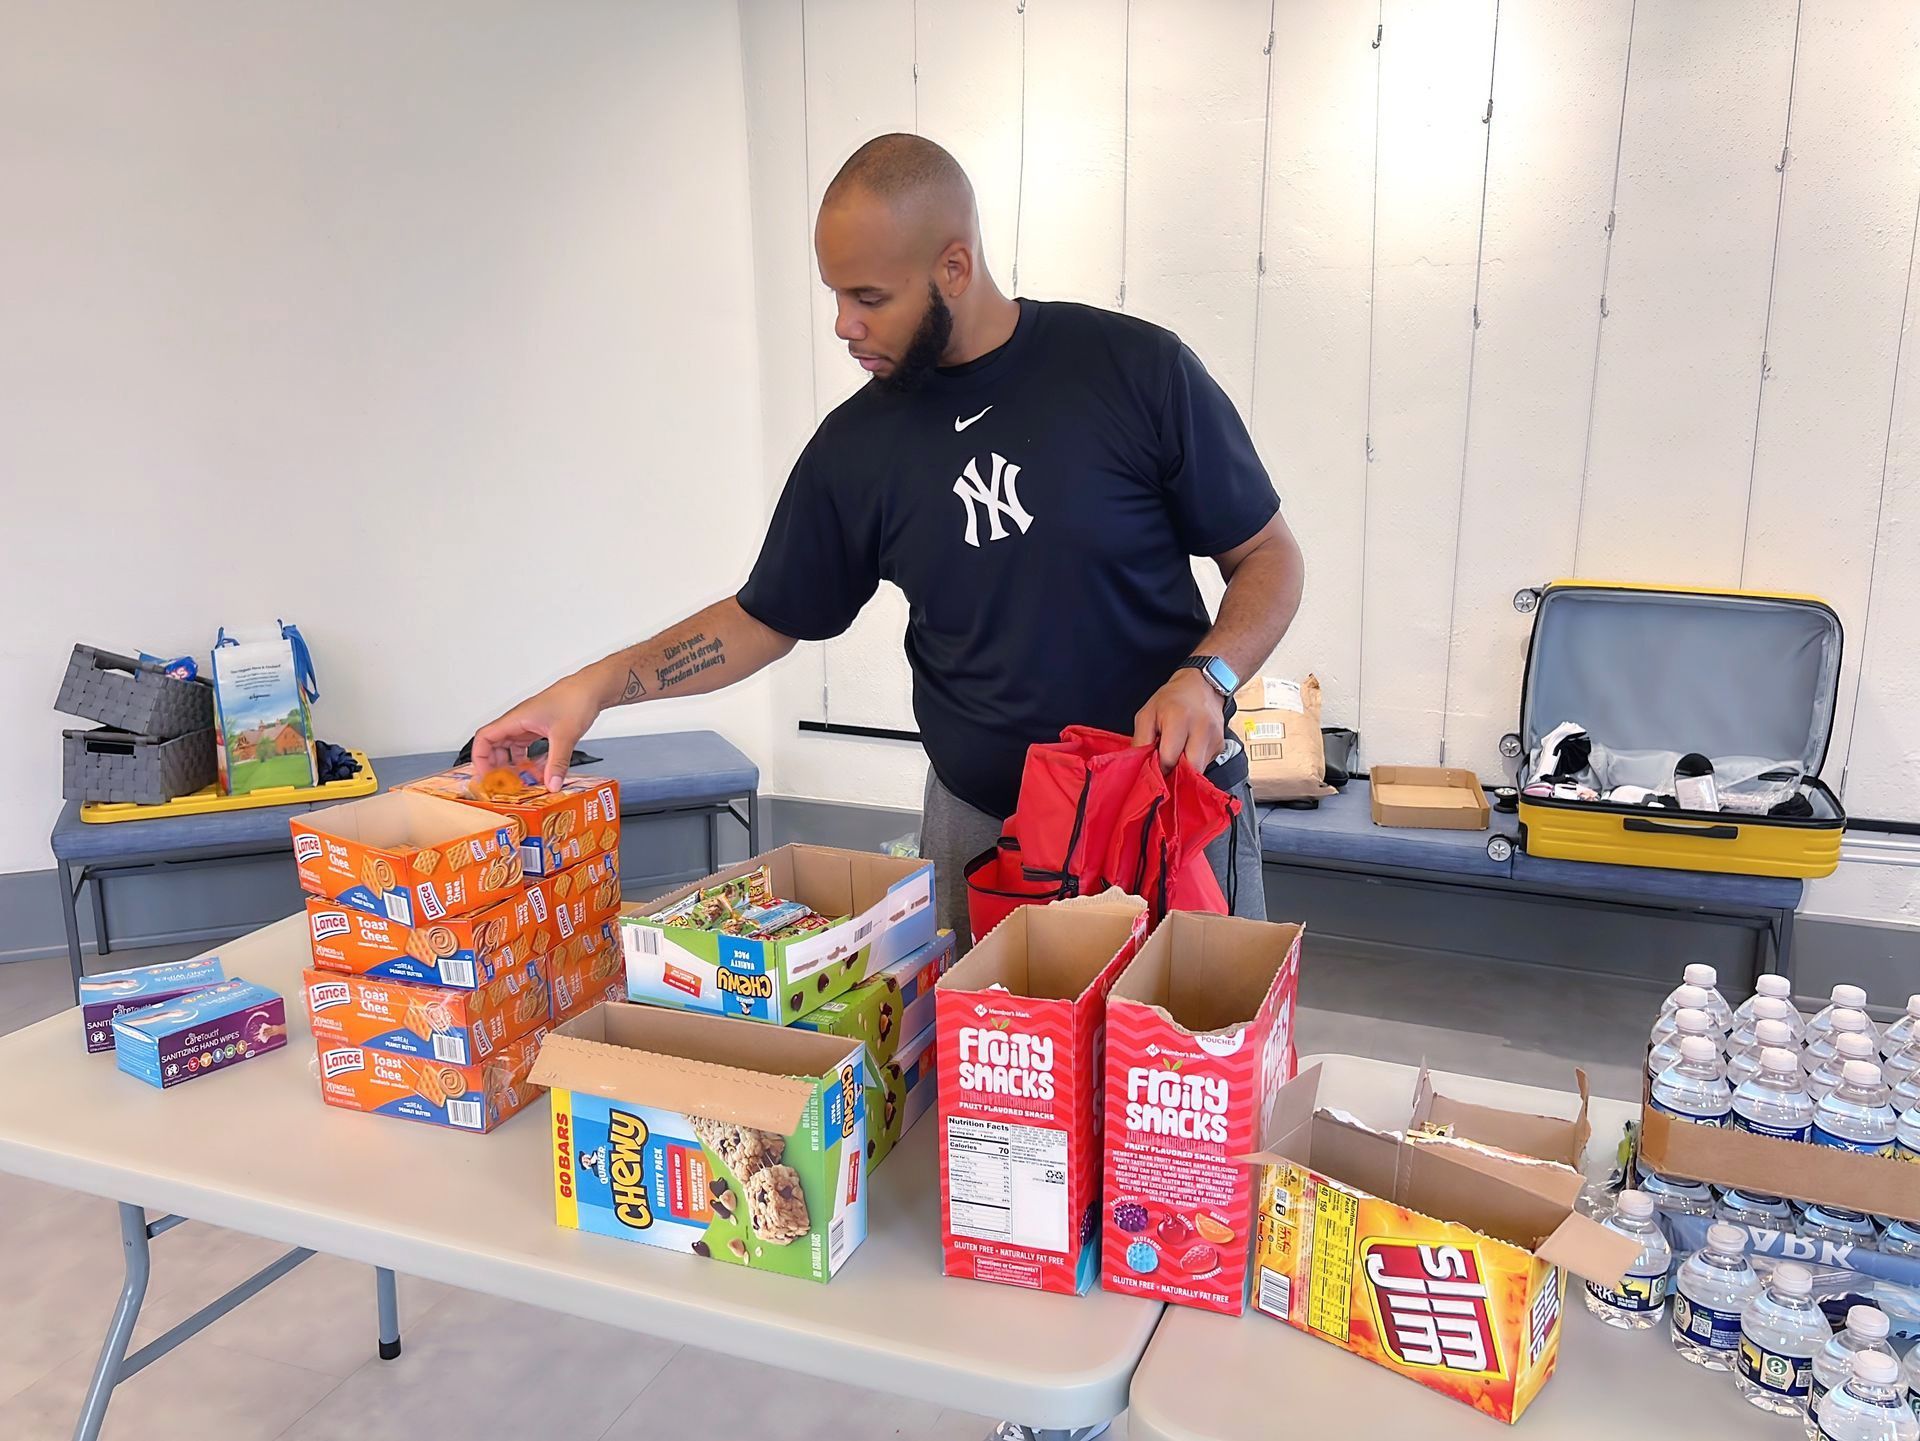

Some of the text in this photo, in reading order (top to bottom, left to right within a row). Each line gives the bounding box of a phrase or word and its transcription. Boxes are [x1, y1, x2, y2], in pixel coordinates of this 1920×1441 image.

[952, 452, 1034, 547] NY
[679, 642, 688, 650] is
[689, 652, 697, 660] is
[693, 664, 700, 673] is
[297, 840, 320, 854] Lance
[325, 840, 348, 857] Toast
[329, 854, 350, 870] Chee
[421, 884, 439, 918] Lance
[314, 916, 346, 932] Lance
[356, 916, 388, 931] Toast
[361, 929, 390, 942] Chee
[312, 987, 346, 1002] Lance
[358, 986, 389, 1002] Toast
[361, 1000, 389, 1014] Chee
[161, 1031, 240, 1064] SANITIZING HAND WIPES
[1201, 1036, 1236, 1046] POUCHES
[325, 1054, 361, 1069] Lance
[372, 1053, 402, 1068] Toast
[374, 1066, 402, 1080] Chee
[960, 1101, 982, 1110] FRUIT
[984, 1105, 1023, 1116] FLAVORED
[1024, 1110, 1055, 1120] SNACKS
[949, 1118, 1009, 1131] Nutrition Facts
[557, 1112, 570, 1170] BARS
[950, 1142, 977, 1150] Calories
[1125, 1142, 1226, 1163] FRUIT FLAVORED SNACKS
[597, 1146, 606, 1184] QUAKER
[1172, 1159, 1192, 1167] SNACKS
[654, 1147, 666, 1208] VARIETY PACK
[1212, 1179, 1232, 1187] SNACKS
[1177, 1213, 1194, 1231] CHERRY
[1132, 1236, 1162, 1251] BLUEBERRY
[954, 1241, 1064, 1265] GLUTEN FREE NATURALLY FAT FREE
[1192, 1267, 1223, 1280] STRAWBERRY
[1113, 1275, 1229, 1303] GLUTEN FREE NATURALLY FAT FREE
